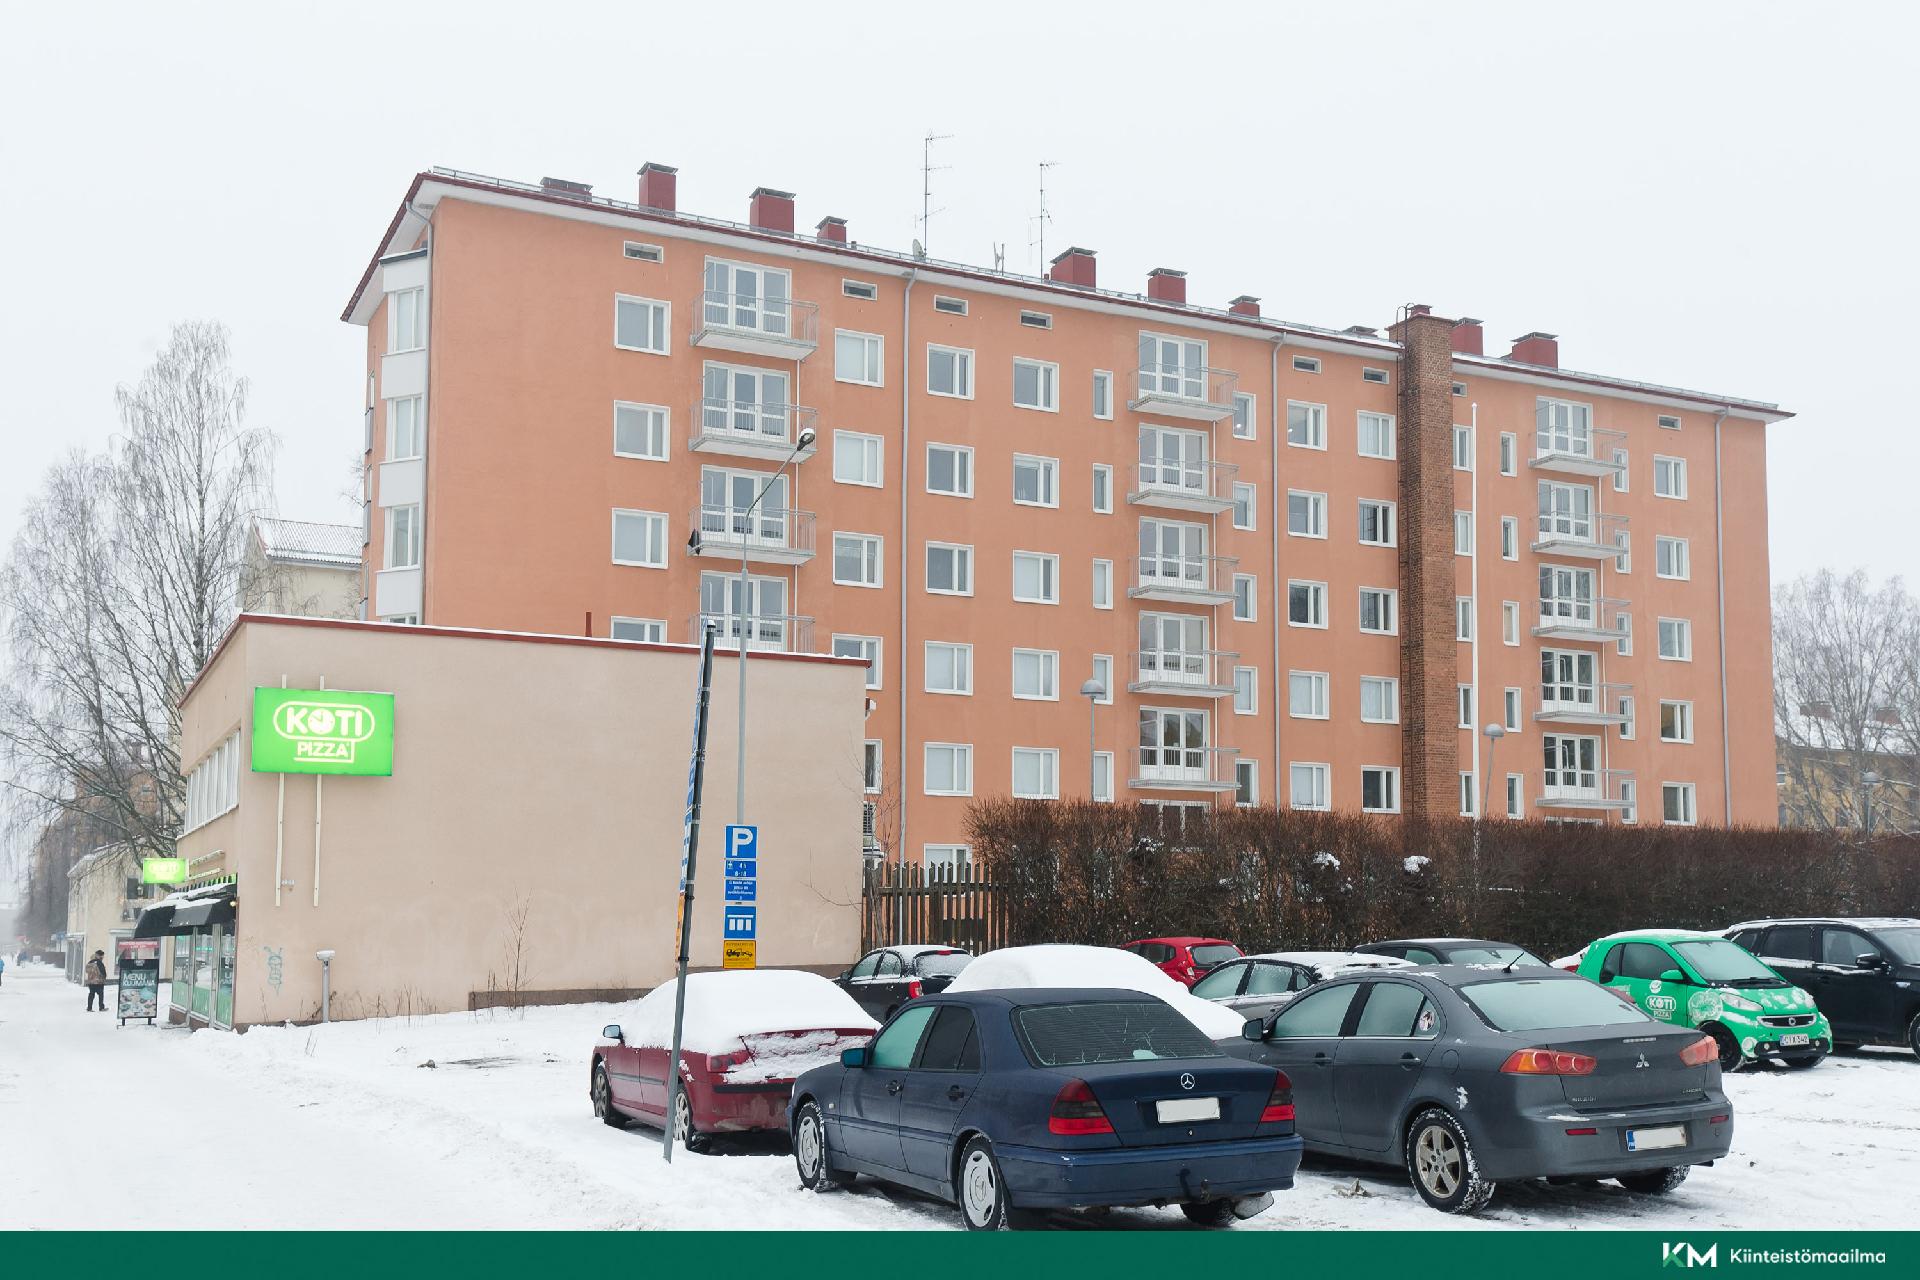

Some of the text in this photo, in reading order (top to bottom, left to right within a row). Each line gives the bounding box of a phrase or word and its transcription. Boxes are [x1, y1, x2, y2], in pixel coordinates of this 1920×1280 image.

[286, 706, 363, 737] KOTI
[297, 742, 349, 758] PIZZA
[731, 827, 754, 857] P
[123, 973, 147, 981] MENU
[1649, 997, 1673, 1010] KOTI
